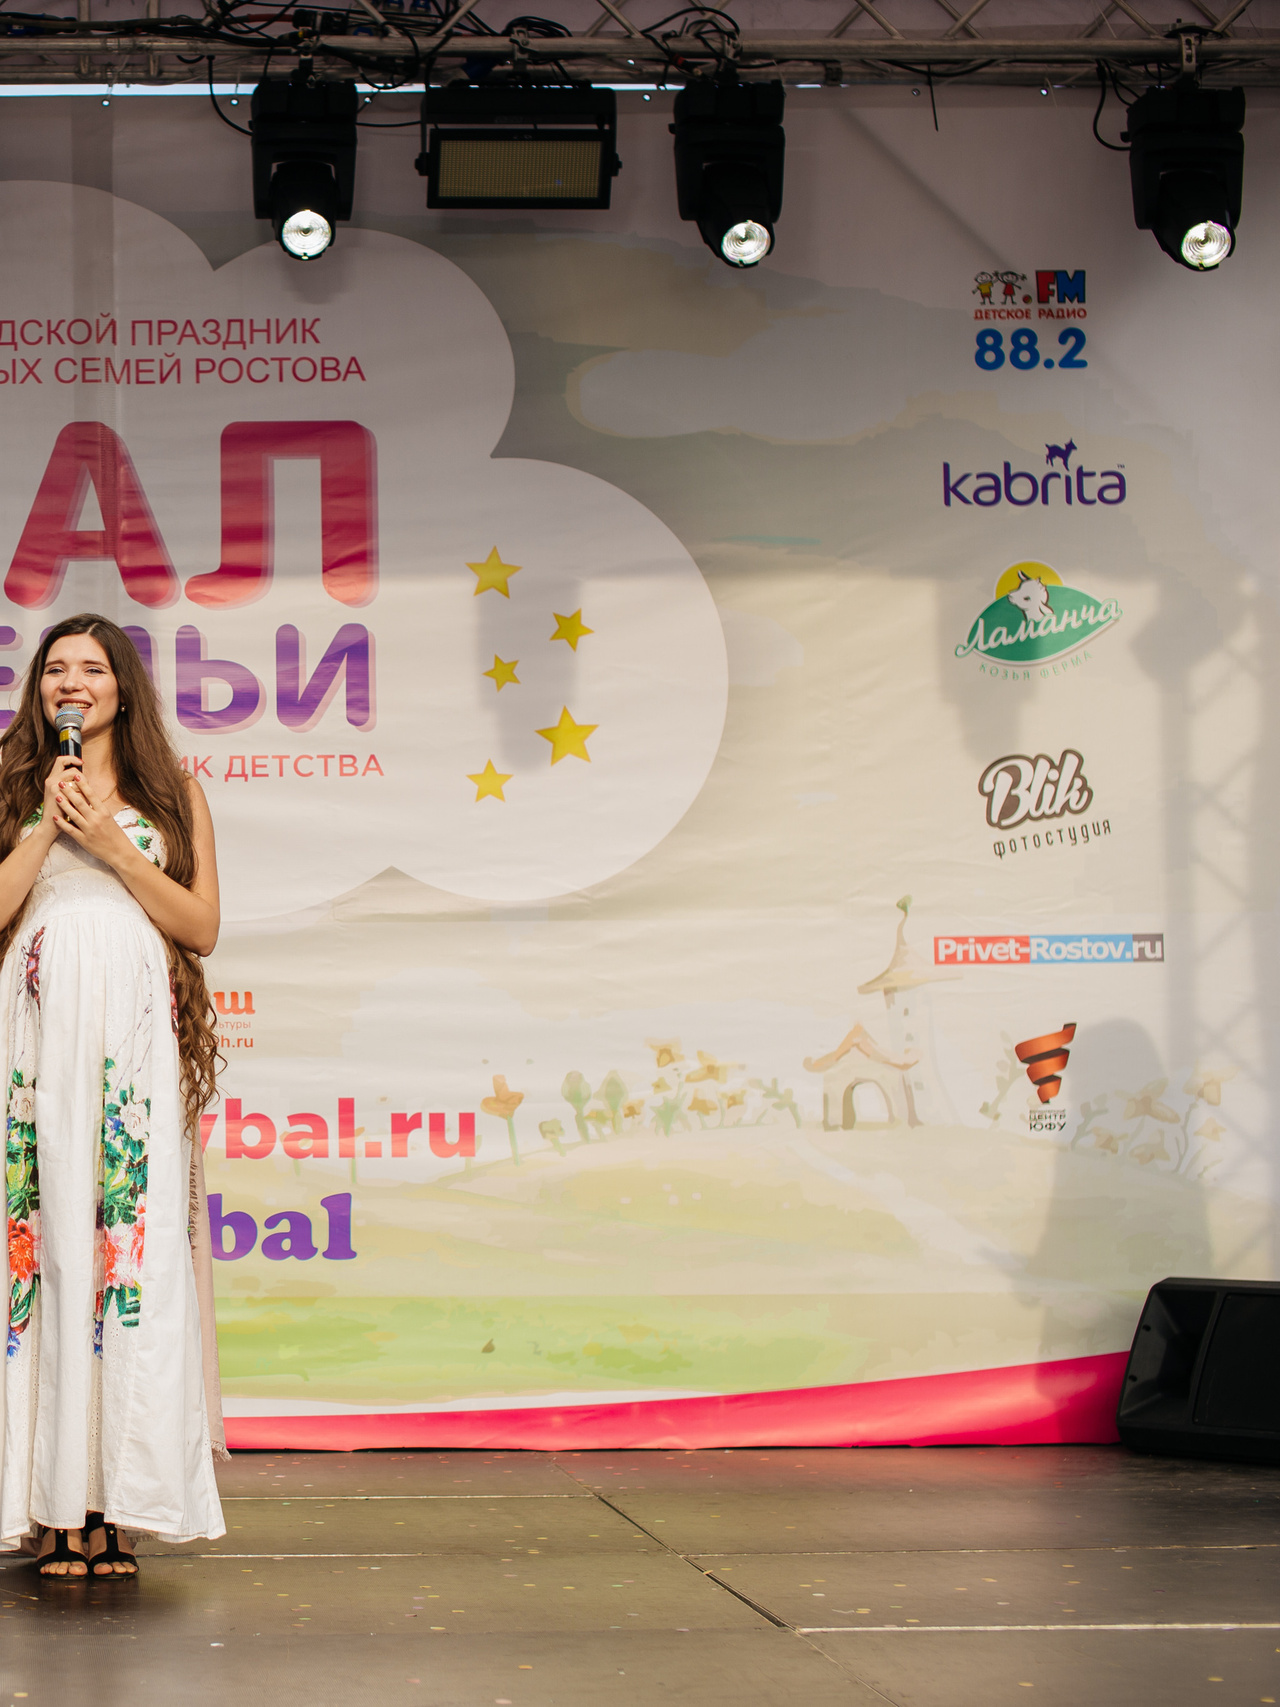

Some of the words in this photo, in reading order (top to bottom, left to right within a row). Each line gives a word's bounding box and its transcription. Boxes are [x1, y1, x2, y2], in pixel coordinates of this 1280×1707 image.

[973, 308, 1032, 321] ДЕТСКОЕ
[1037, 307, 1088, 320] РАДИО
[130, 317, 321, 350] ПРАЗДНИК
[974, 326, 1089, 371] 88.2
[53, 353, 183, 385] СЕМЕЙ
[194, 355, 367, 385] РОСТОВА
[942, 460, 1127, 508] kabrita
[954, 598, 1124, 658] Ламанча
[978, 661, 1031, 681] КОЗЬЯ
[1039, 650, 1094, 678] ФЕРМА
[224, 753, 385, 783] ДЕТСТВА
[978, 749, 1094, 830] Blik
[937, 937, 1163, 962] Privet-Rostov.ru
[1028, 1121, 1067, 1132] ЮФУ
